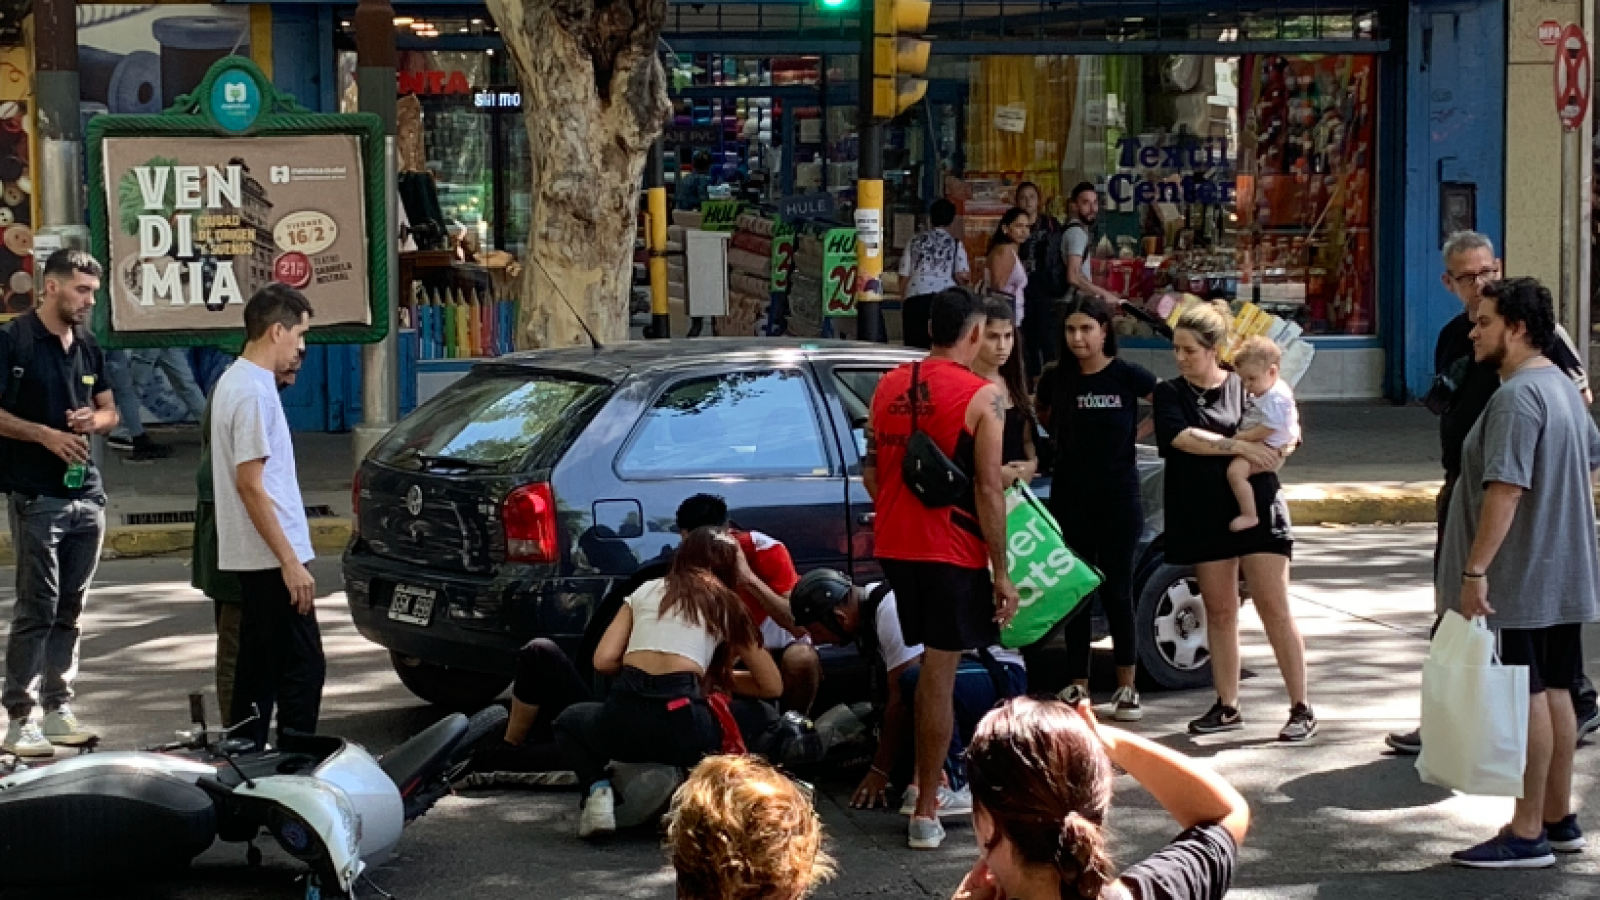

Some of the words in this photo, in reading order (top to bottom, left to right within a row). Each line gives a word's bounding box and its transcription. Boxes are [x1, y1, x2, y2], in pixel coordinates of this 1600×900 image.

[396, 70, 469, 94] NTA
[1116, 136, 1230, 167] Textil
[134, 165, 242, 210] VEN
[1108, 173, 1238, 204] Center
[703, 204, 740, 223] HUL
[786, 199, 827, 216] HULE
[137, 214, 194, 258] DI
[287, 226, 326, 245] 16/2
[827, 233, 858, 254] HU
[140, 261, 244, 306] MIA
[887, 401, 935, 416] adias
[1076, 391, 1123, 409] TÓXICA
